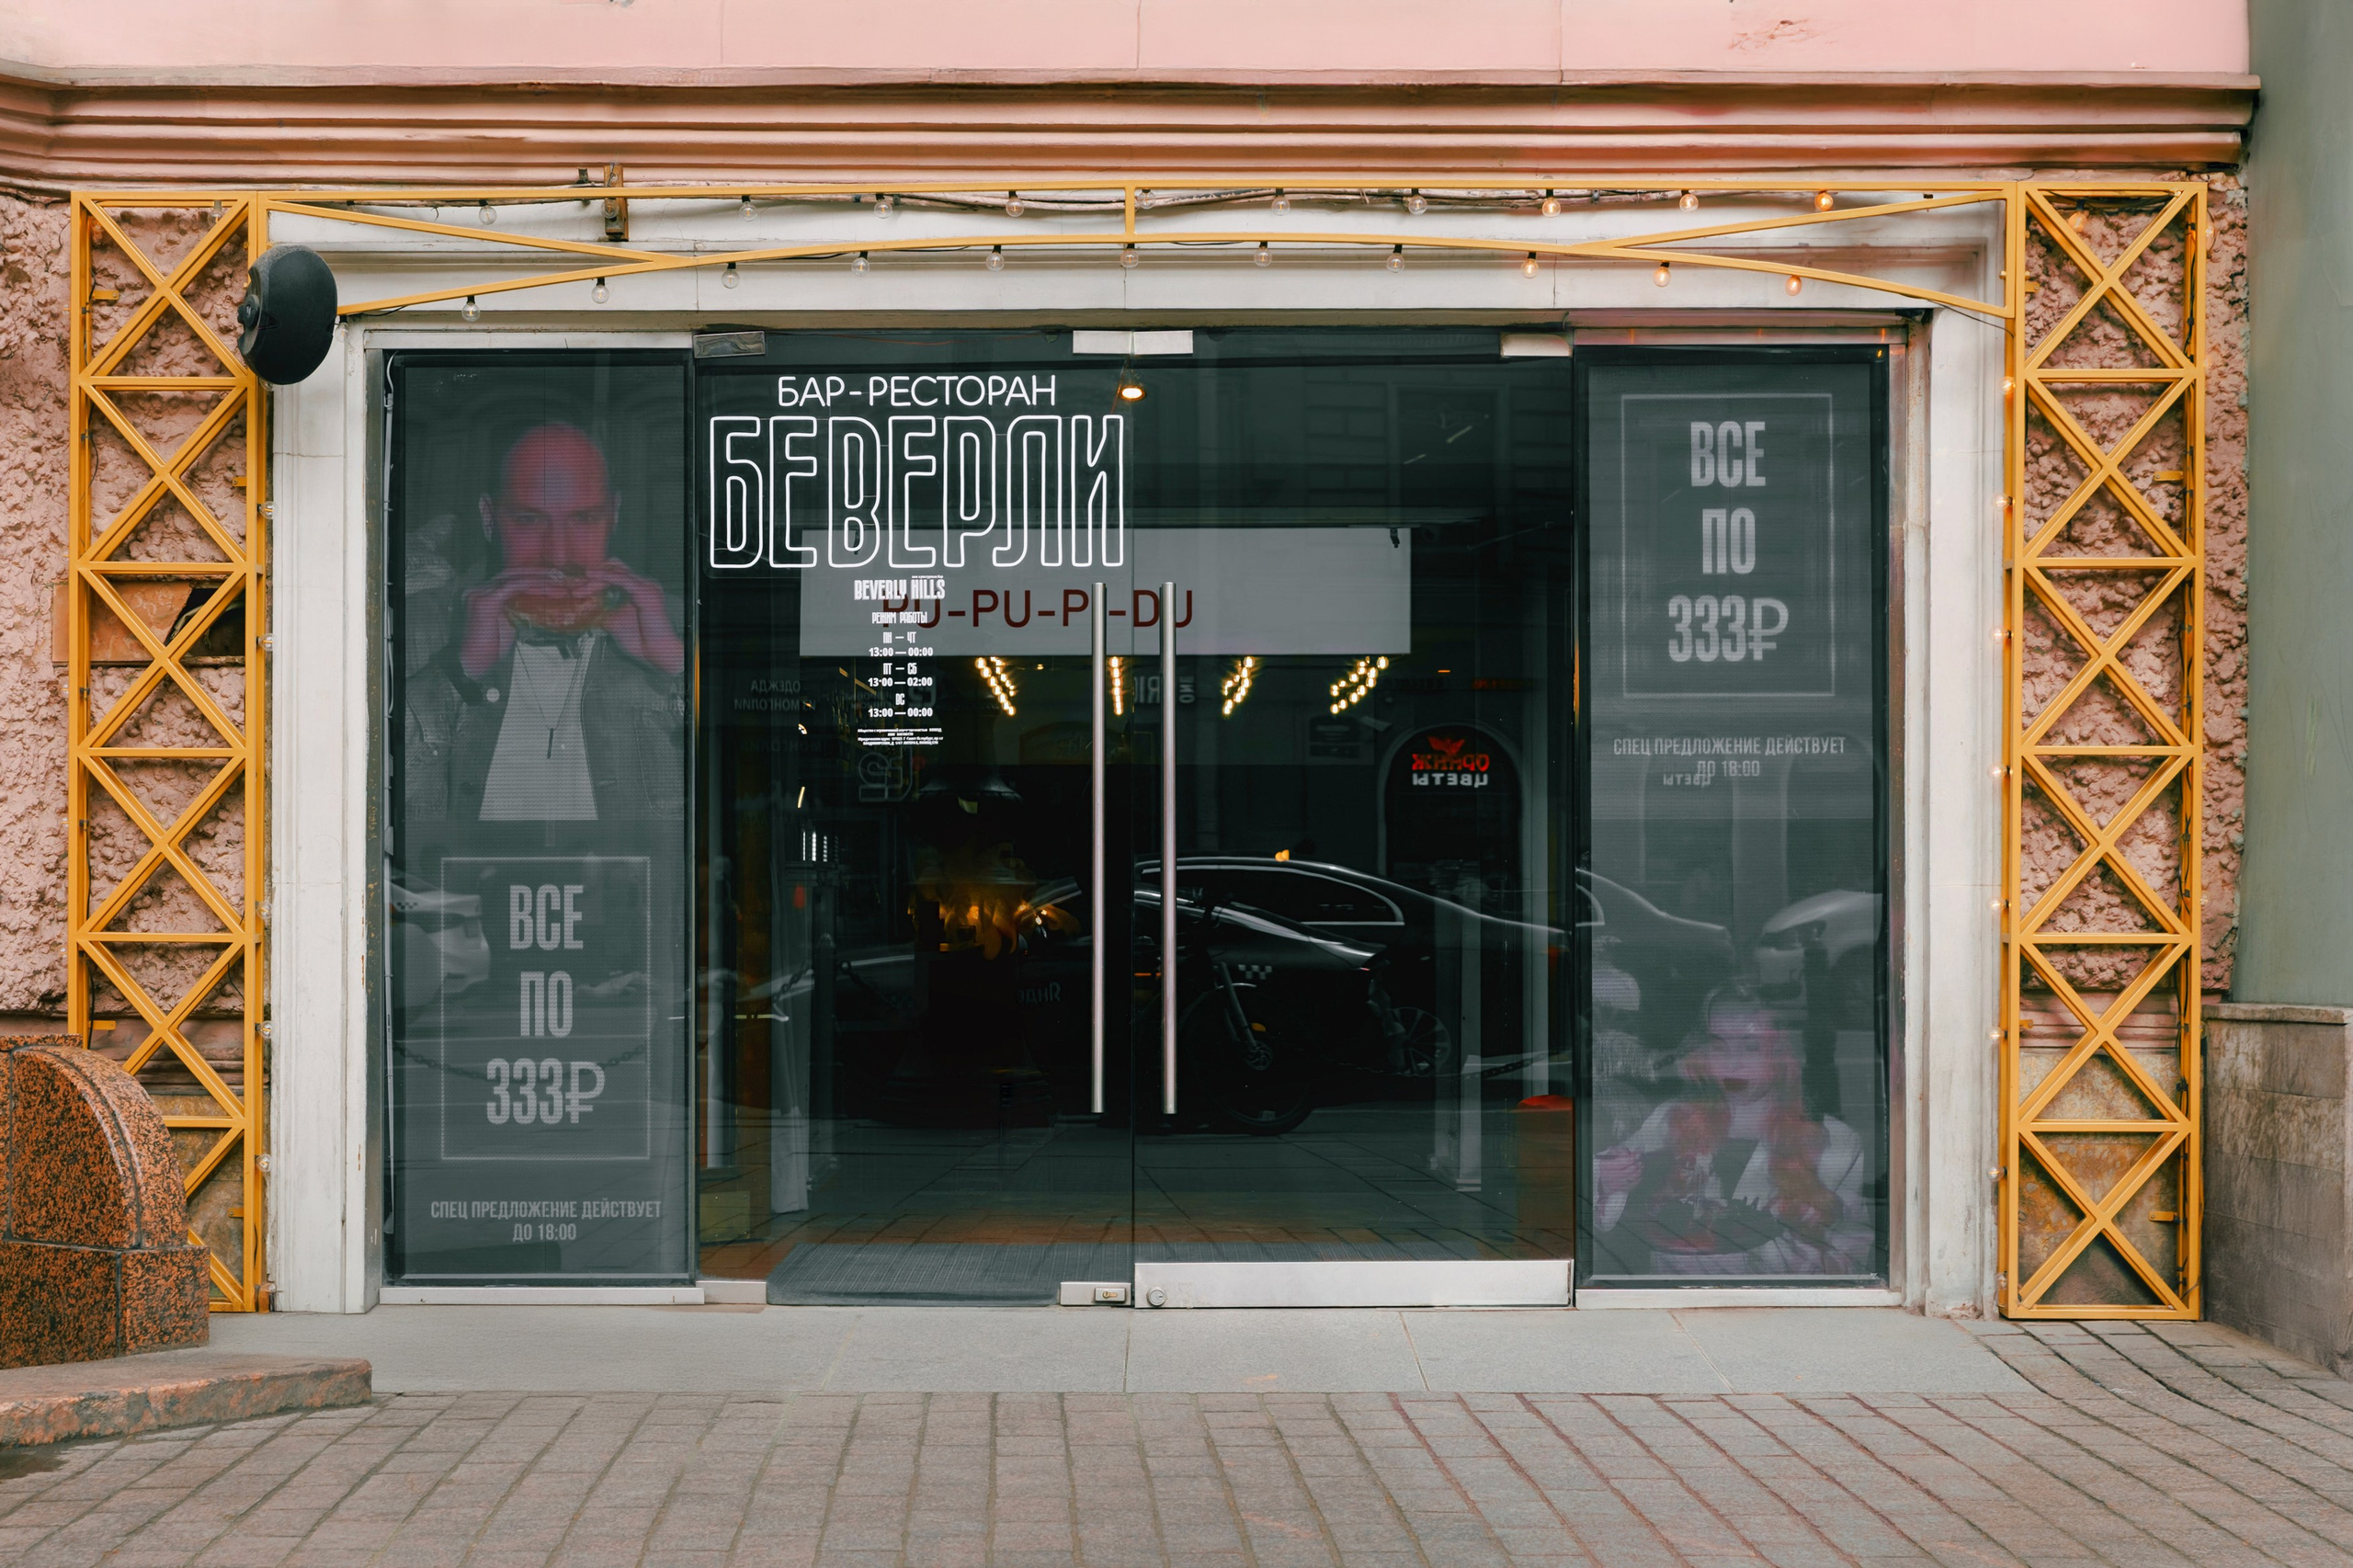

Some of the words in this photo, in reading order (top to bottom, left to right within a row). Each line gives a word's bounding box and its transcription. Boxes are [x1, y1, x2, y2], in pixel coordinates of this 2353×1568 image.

[778, 374, 1056, 407] БАР-РЕСТОРАН
[1689, 420, 1767, 488] ВСЕ
[710, 414, 1124, 569] БЕВЕРЛИ
[1701, 506, 1756, 575] ПО
[853, 579, 907, 600] BEVERLY
[910, 579, 946, 599] HILLS
[871, 611, 897, 624] РЕЖИМ
[899, 611, 928, 624] РАБОТЫ
[906, 631, 917, 643] ЧТ
[869, 646, 894, 657] 13:00
[907, 646, 934, 657] 00:00
[882, 663, 892, 676] ПТ
[907, 662, 917, 676] СБ
[906, 676, 933, 687] 02:00
[868, 707, 893, 718] 13:00
[907, 707, 934, 718] 00:00
[1612, 738, 1650, 756] СПЕЦ
[1654, 737, 1762, 756] ПРЕДЛОЖЕНИЕ
[1765, 734, 1847, 756] ДЕЙСТВУЕТ
[1722, 760, 1760, 778] 18:00
[509, 883, 585, 951] ВСЕ
[519, 970, 574, 1039] ПО
[430, 1201, 468, 1221] СПЕЦ
[472, 1200, 577, 1221] ПРЕДЛОЖЕНИЕ
[581, 1198, 662, 1220] ДЕЙСТВУЕТ
[512, 1223, 533, 1243] ДО
[537, 1223, 577, 1240] 18:00
